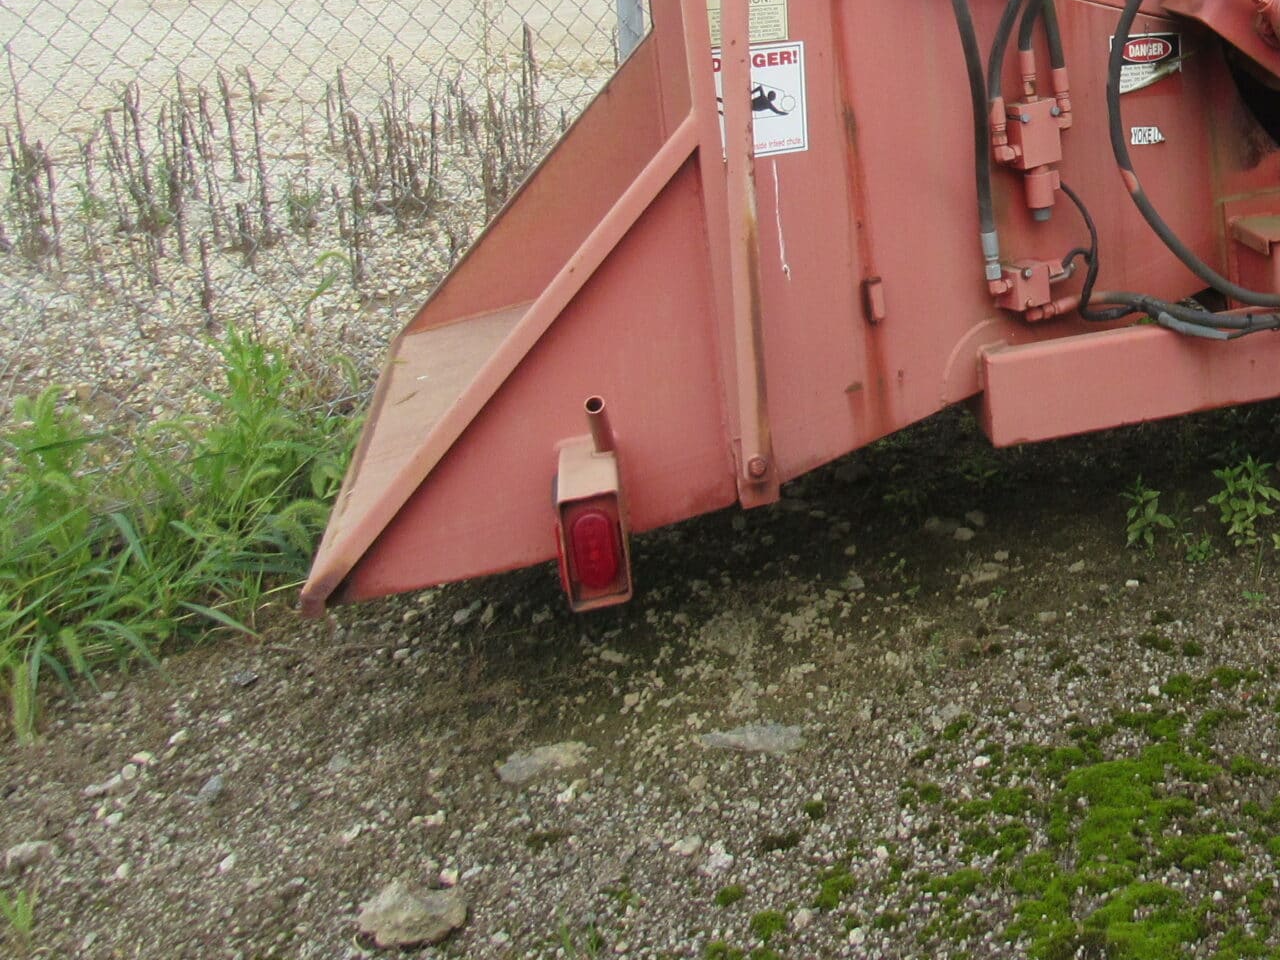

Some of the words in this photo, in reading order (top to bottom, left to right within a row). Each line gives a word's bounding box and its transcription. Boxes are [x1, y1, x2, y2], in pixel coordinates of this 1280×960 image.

[1128, 42, 1165, 58] DANGER
[712, 50, 798, 73] DGER!
[1133, 128, 1152, 143] YOKE
